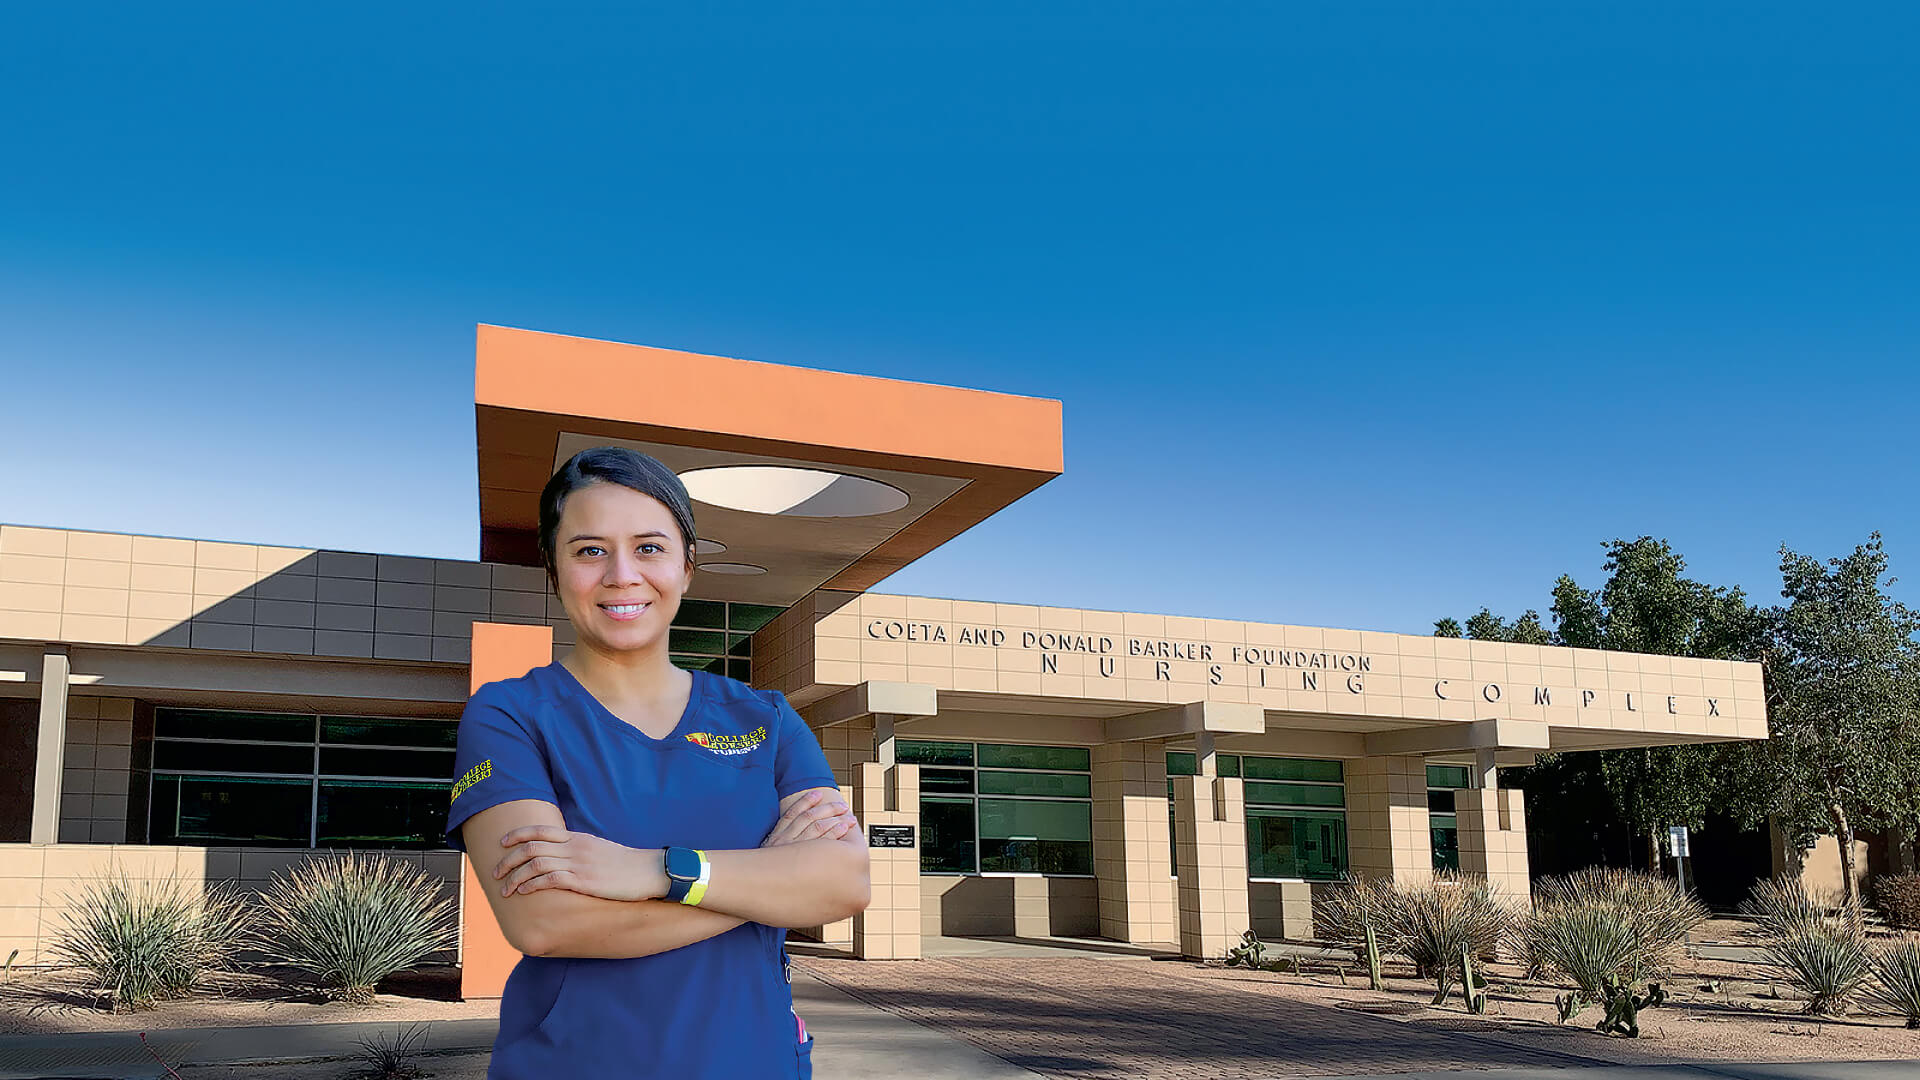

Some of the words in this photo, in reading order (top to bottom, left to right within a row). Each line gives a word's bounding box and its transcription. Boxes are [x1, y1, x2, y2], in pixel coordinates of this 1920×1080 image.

[868, 621, 947, 643] COETA
[959, 628, 1005, 647] AND
[1023, 631, 1113, 654] DONALD
[1129, 640, 1213, 661] BARKER
[1232, 647, 1371, 672] FOUNDATION
[1042, 653, 1363, 694] NURSING
[1435, 679, 1720, 717] COMPLEX
[707, 726, 766, 743] COLLEGE
[719, 732, 767, 750] DESERT
